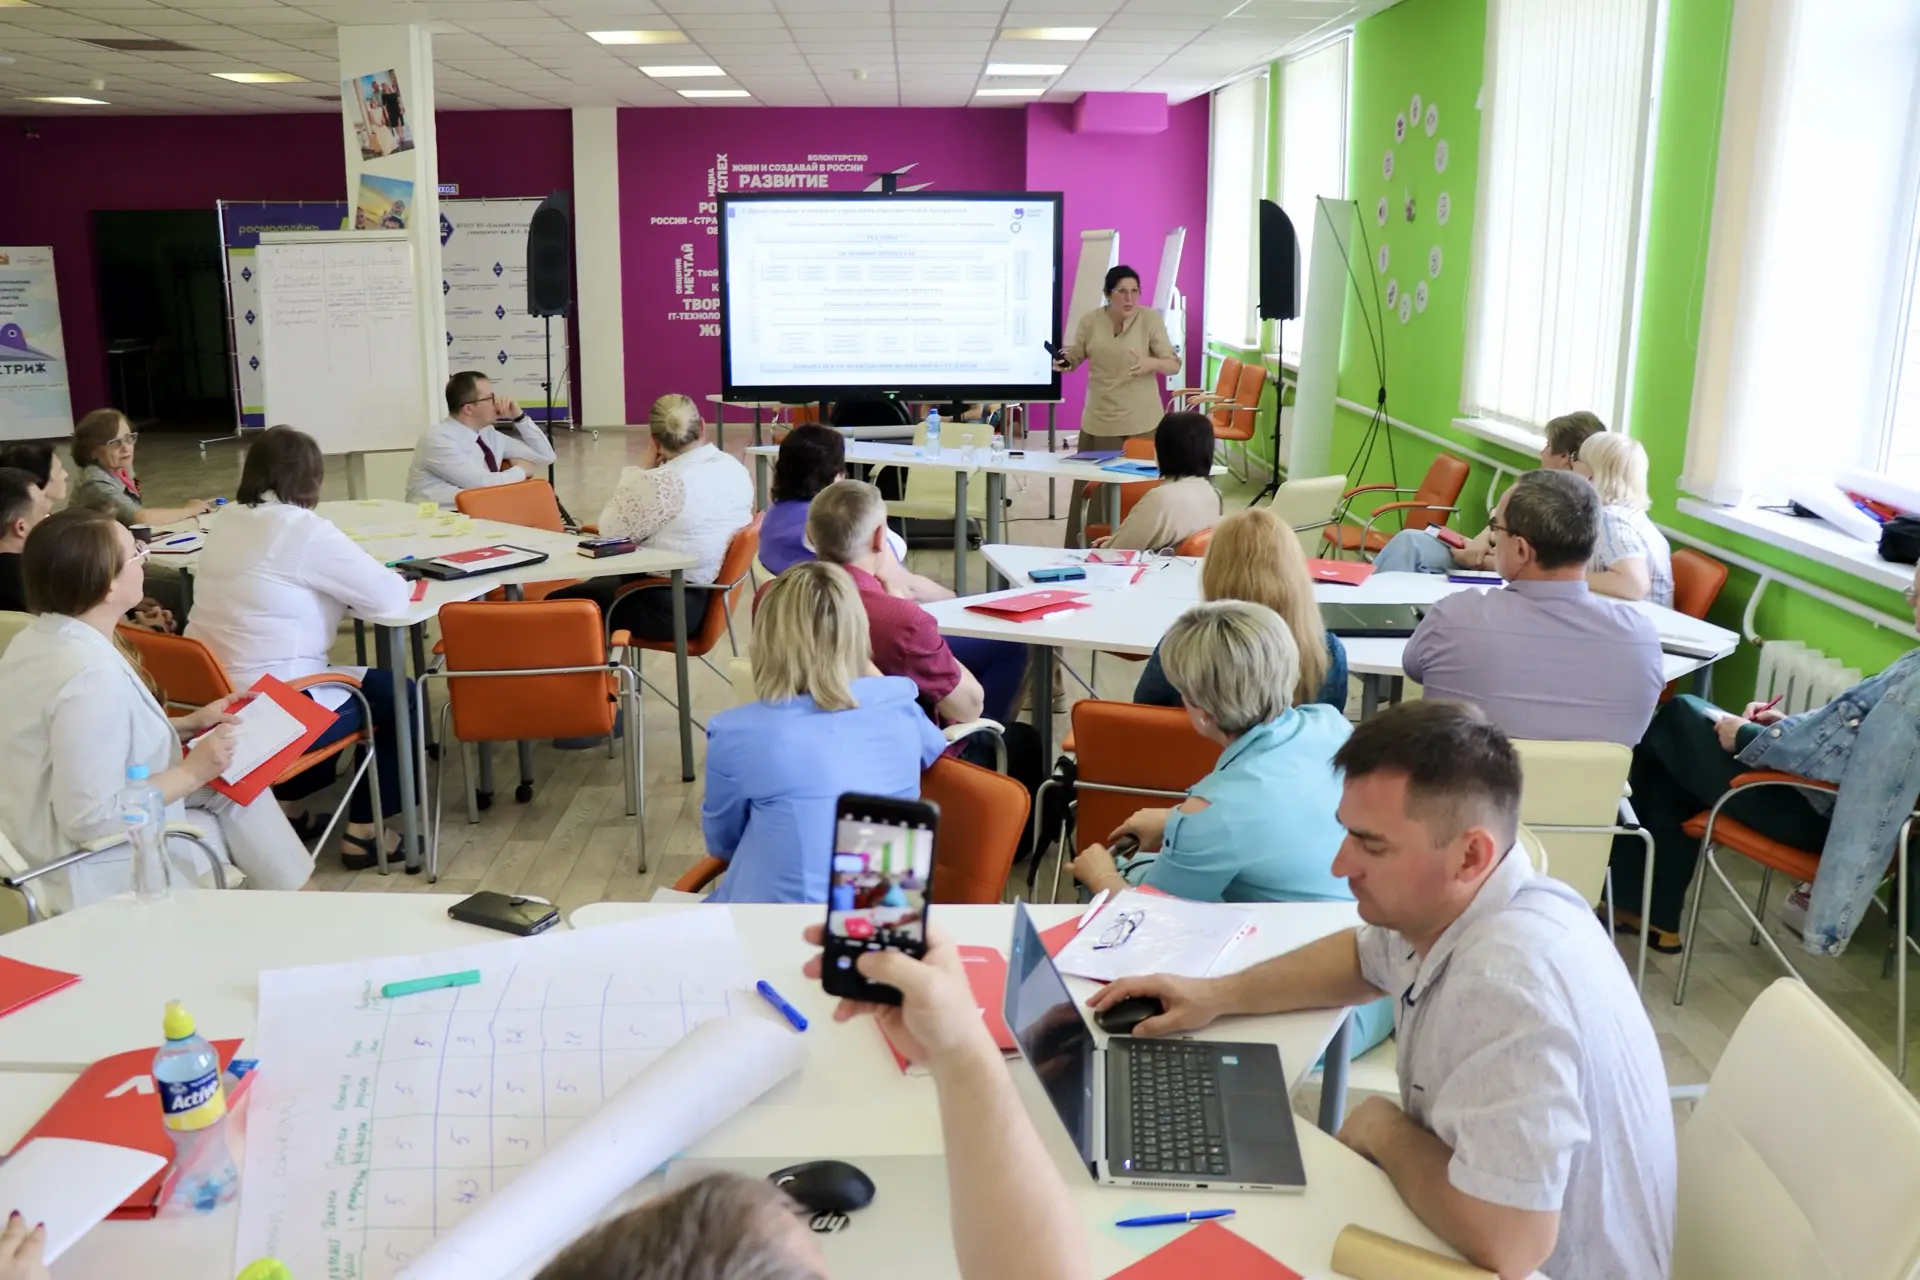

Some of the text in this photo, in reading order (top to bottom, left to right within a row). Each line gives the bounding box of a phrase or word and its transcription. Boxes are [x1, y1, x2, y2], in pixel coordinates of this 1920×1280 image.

[732, 162, 864, 172] ЖИВИ И СОЗДАВАЙ В РОССИИ
[738, 174, 829, 188] РАЗВИТИЕ
[650, 216, 688, 225] РОССИЯ
[681, 244, 694, 294] МЕЧТАЙ
[682, 298, 720, 310] ТВОР
[812, 1212, 847, 1232] hp
